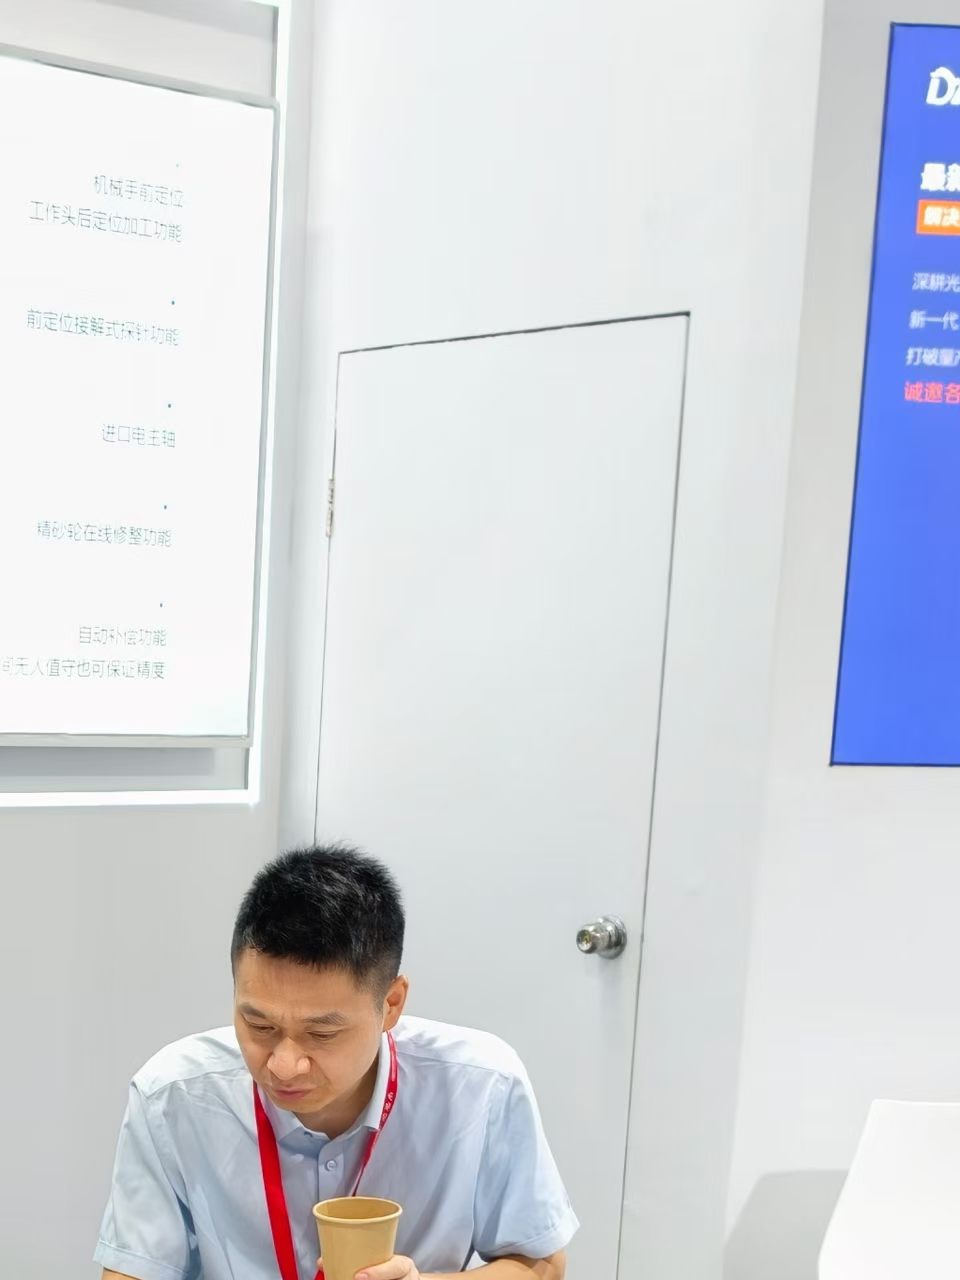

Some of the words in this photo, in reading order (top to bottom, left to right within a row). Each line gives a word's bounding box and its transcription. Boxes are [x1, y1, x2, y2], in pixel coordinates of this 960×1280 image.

[926, 66, 960, 106] D
[93, 175, 184, 208] 机械手前定位
[29, 200, 183, 243] 工作头后定位加工功能
[101, 422, 176, 449] 进口电主轴
[36, 520, 172, 548] 精砂轮在线修整功能
[79, 625, 167, 647] 自动补偿功能
